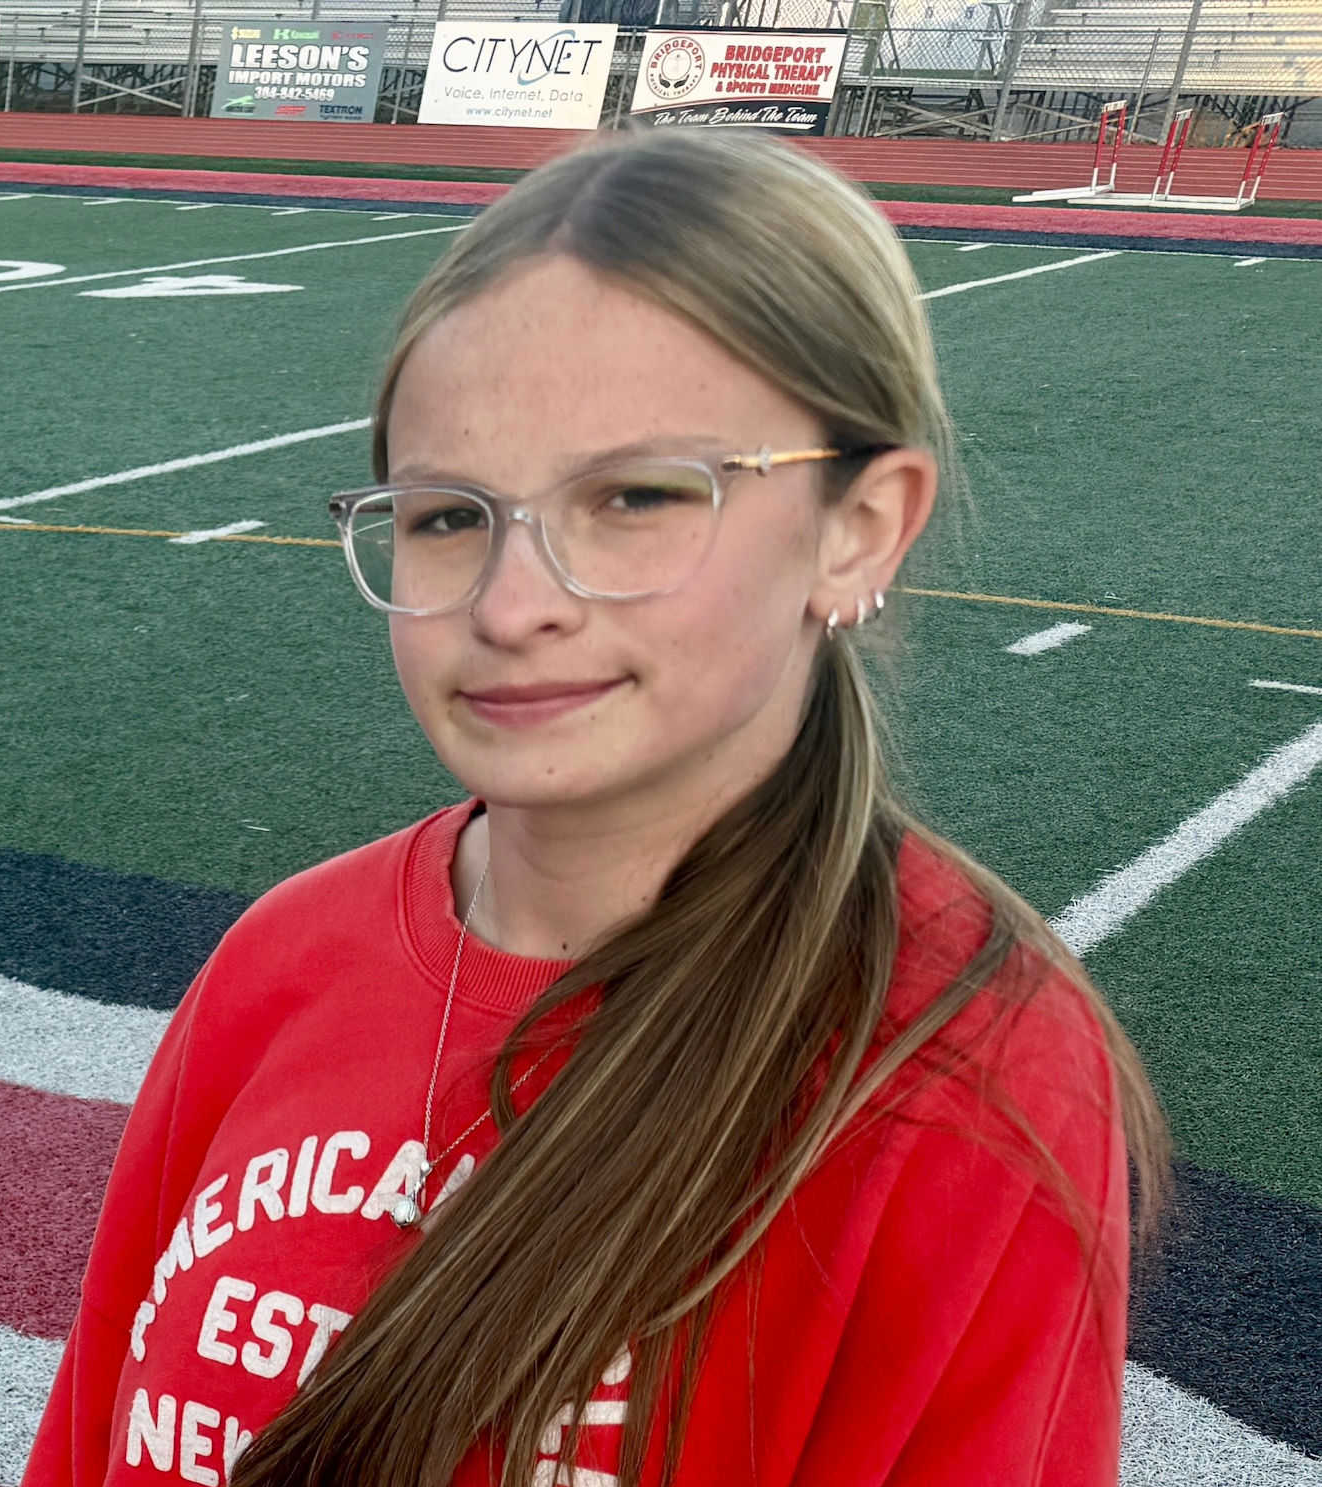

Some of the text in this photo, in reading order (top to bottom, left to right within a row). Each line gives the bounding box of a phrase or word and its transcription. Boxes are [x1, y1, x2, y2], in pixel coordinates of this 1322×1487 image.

[230, 43, 370, 71] LEESON'S
[443, 36, 602, 75] CITYNET
[650, 40, 702, 69] BRIDGEPORT
[724, 45, 825, 63] BRIDGEPORT
[228, 70, 367, 88] IMPORT MOTORS
[710, 62, 833, 82] PHYSICAL THERAPY
[254, 86, 335, 102] 304-842-5469
[444, 87, 583, 102] Voice, Internet, Data
[715, 80, 820, 95] & SPORTS MEDICINE
[319, 105, 363, 115] TEXTRON
[466, 106, 553, 118] www.citynet.net
[654, 106, 818, 125] The Team Behind The Team
